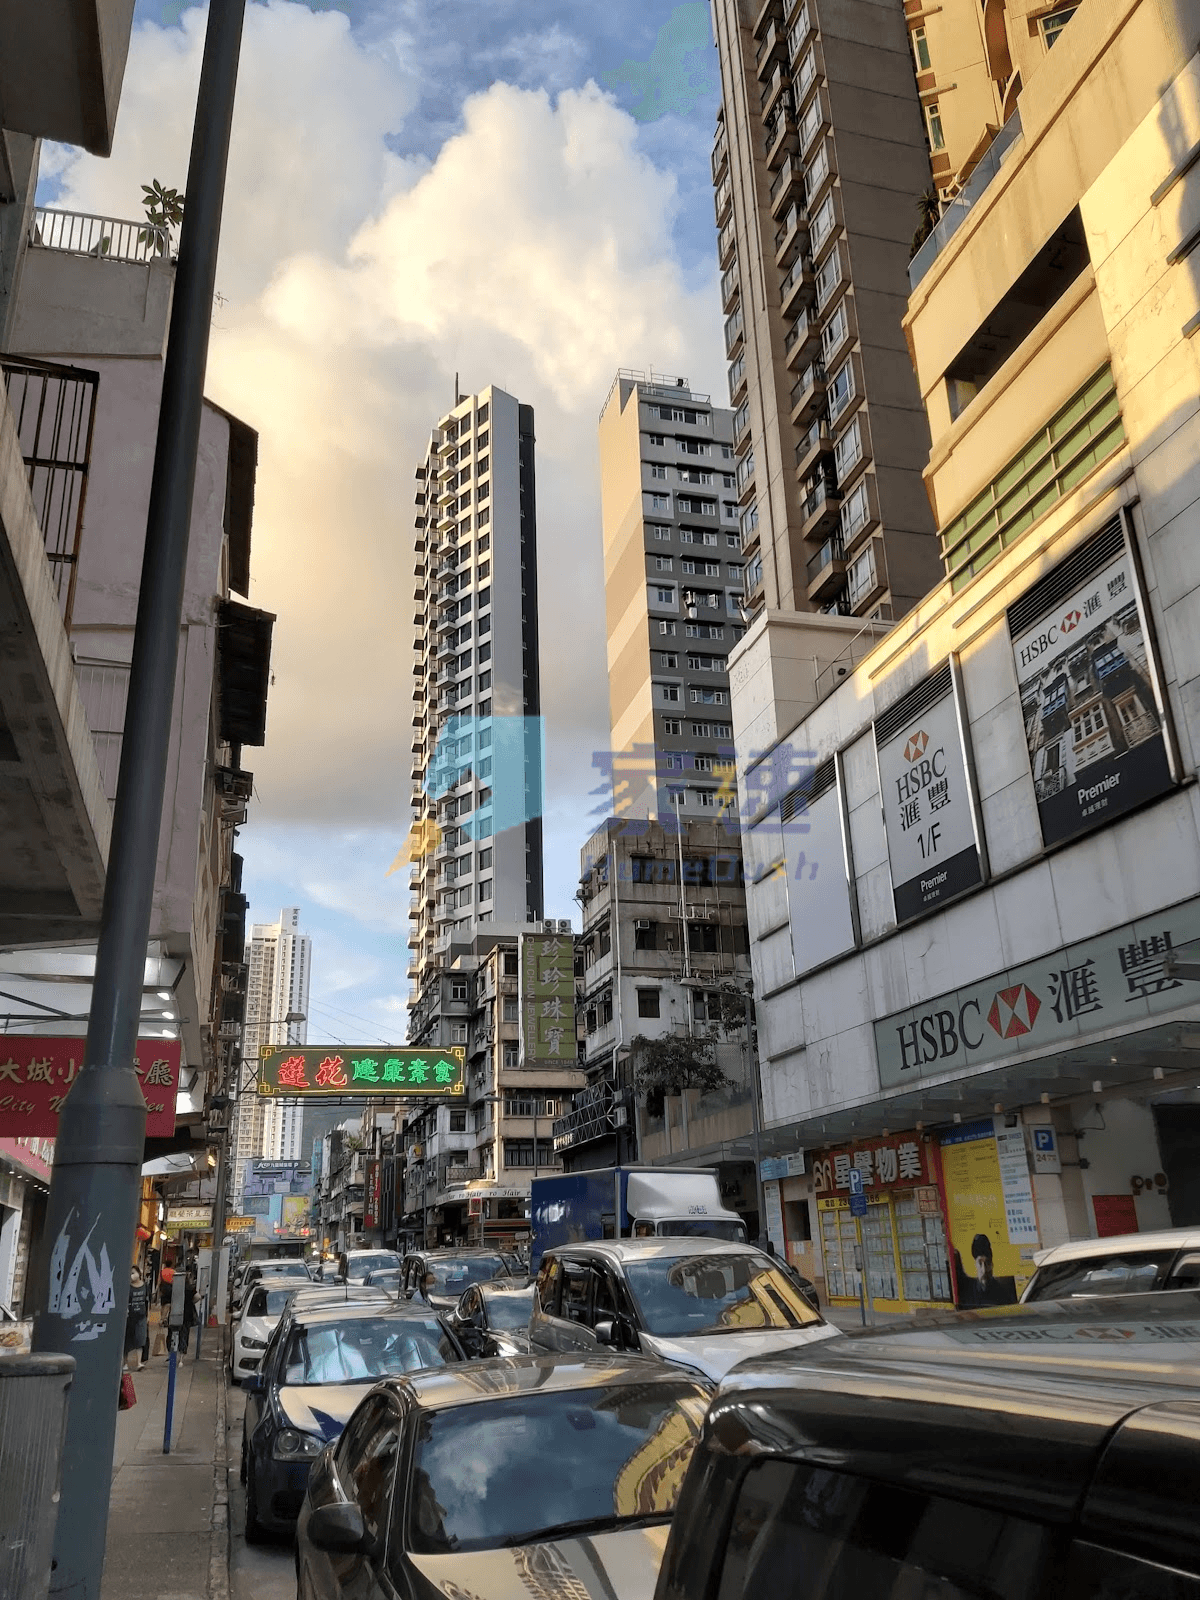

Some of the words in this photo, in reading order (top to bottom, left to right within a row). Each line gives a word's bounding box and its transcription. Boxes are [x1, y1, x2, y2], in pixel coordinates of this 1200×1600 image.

[1020, 625, 1058, 668] HSBC
[895, 747, 946, 805] HSBC
[1077, 772, 1120, 805] Premier
[917, 821, 941, 859] 1/F
[920, 871, 948, 892] Premier
[526, 937, 535, 966] CHUN
[526, 968, 535, 999] CHUN
[896, 998, 984, 1070] HSBC
[1037, 1132, 1050, 1148] P
[850, 1170, 860, 1191] P
